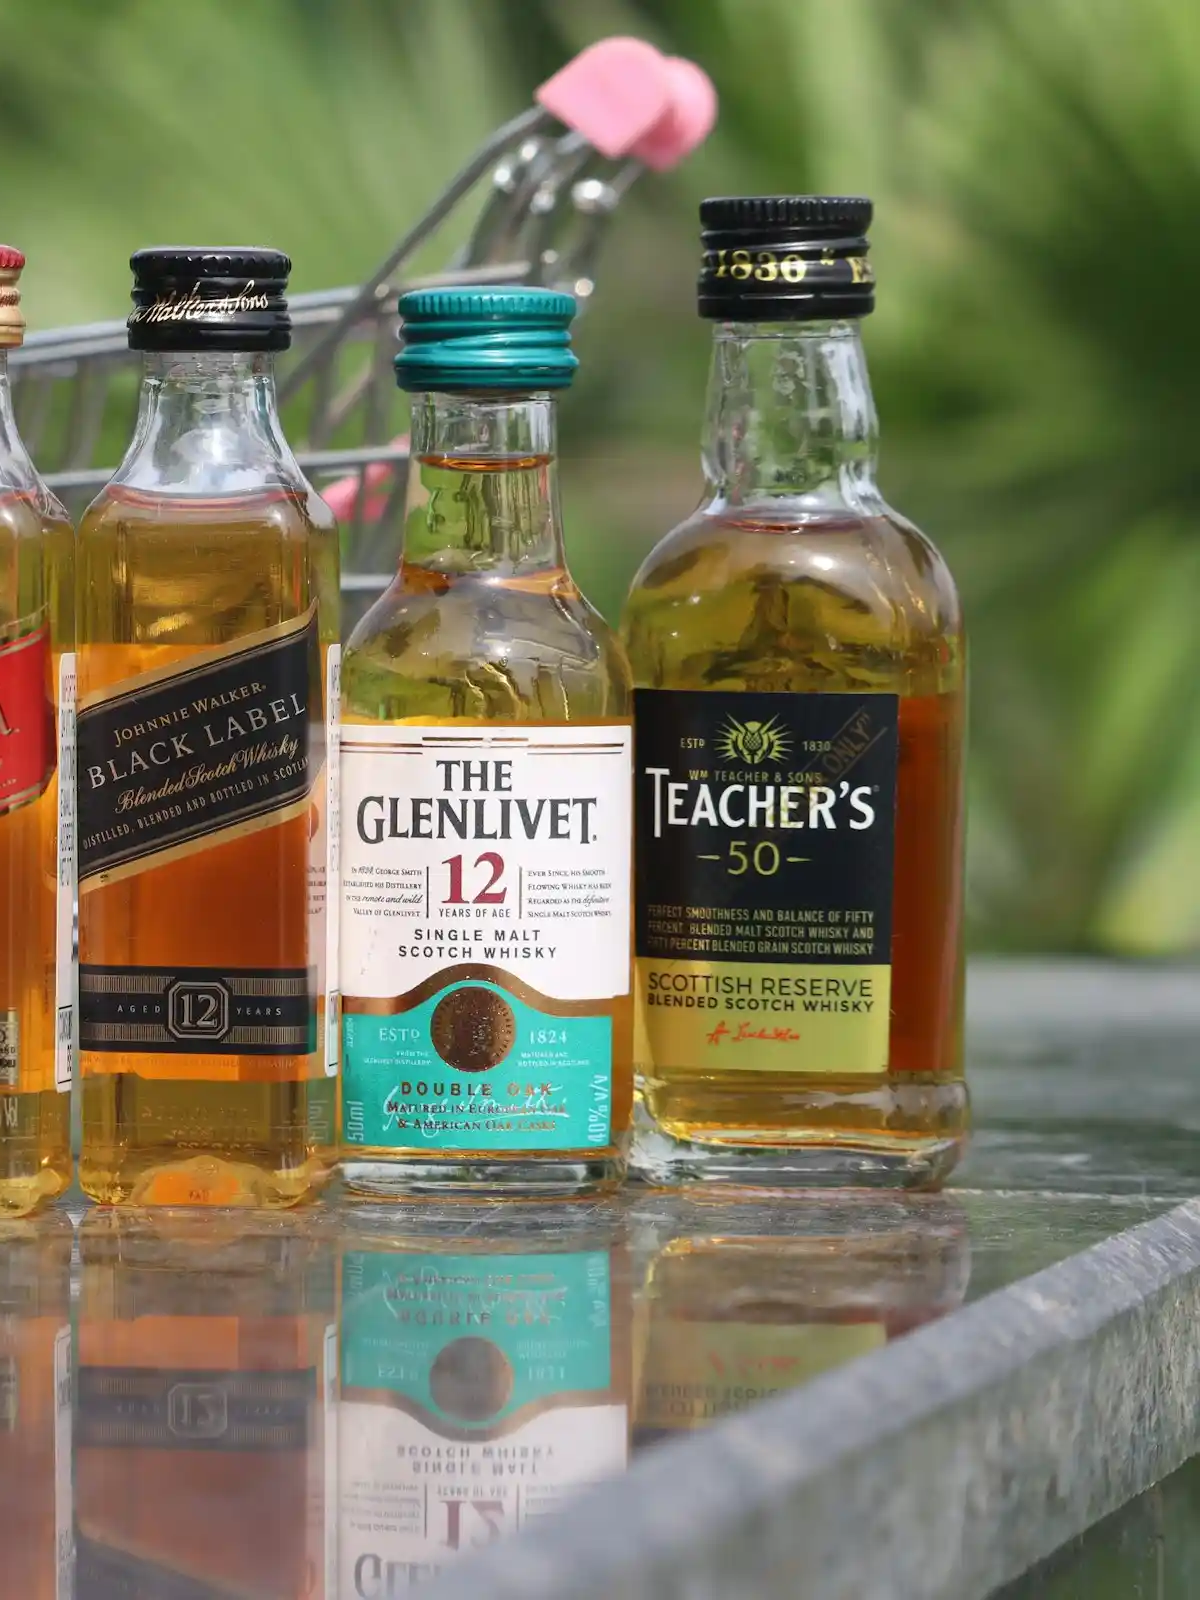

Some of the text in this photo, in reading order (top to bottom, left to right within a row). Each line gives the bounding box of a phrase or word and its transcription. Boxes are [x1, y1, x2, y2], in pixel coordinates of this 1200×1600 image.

[113, 682, 263, 748] JOHNNIE WALKER
[87, 693, 306, 789] BLACK LABEL
[803, 741, 831, 751] 1830
[115, 734, 300, 814] Blended Scotch Whisky
[436, 760, 512, 792] THE
[715, 771, 769, 782] TEACHER
[774, 772, 782, 782] &
[787, 772, 822, 783] SONS
[137, 807, 182, 830] BLENDED
[187, 796, 206, 812] AND
[209, 779, 254, 803] BOTTLED
[257, 774, 268, 786] IN
[645, 767, 876, 837] TEACHER'S
[356, 796, 597, 844] GLENLIVET
[727, 841, 780, 875] 50
[375, 867, 400, 876] GEORGE
[441, 851, 508, 904] 12
[383, 909, 421, 917] GLENLIVET
[439, 908, 511, 918] YEARS OF AGE
[685, 906, 749, 920] SMOOTHNESS
[752, 909, 773, 921] AND
[777, 910, 824, 922] BALANCE
[828, 911, 841, 923] OF
[845, 911, 874, 923] FIFTY
[414, 929, 541, 941] SINGLE MALT
[689, 923, 732, 936] BLENDED
[735, 925, 762, 937] MALT
[765, 926, 805, 938] SCOTCH
[808, 927, 849, 938] WHISKY
[852, 927, 874, 939] AND
[398, 945, 557, 959] SCOTCH WHISKY
[670, 938, 711, 951] PERCENT
[712, 939, 756, 952] BLENDED
[757, 941, 788, 953] GRAIN
[791, 942, 831, 954] SCOTCH
[833, 943, 874, 955] WHISKY
[648, 972, 873, 997] SCOTTISH RESERVE
[117, 993, 282, 1028] AGED 12 YEARS
[647, 993, 875, 1013] BLENDED SCOTCH WHISKY
[530, 1030, 567, 1044] 1824
[401, 1081, 552, 1096] DOUBLE OAK
[387, 1101, 447, 1114] MATURED
[451, 1104, 464, 1114] IN
[346, 1100, 364, 1141] 50ml
[397, 1118, 408, 1129] &
[412, 1119, 481, 1131] AMERICAN
[486, 1119, 512, 1130] OAK
